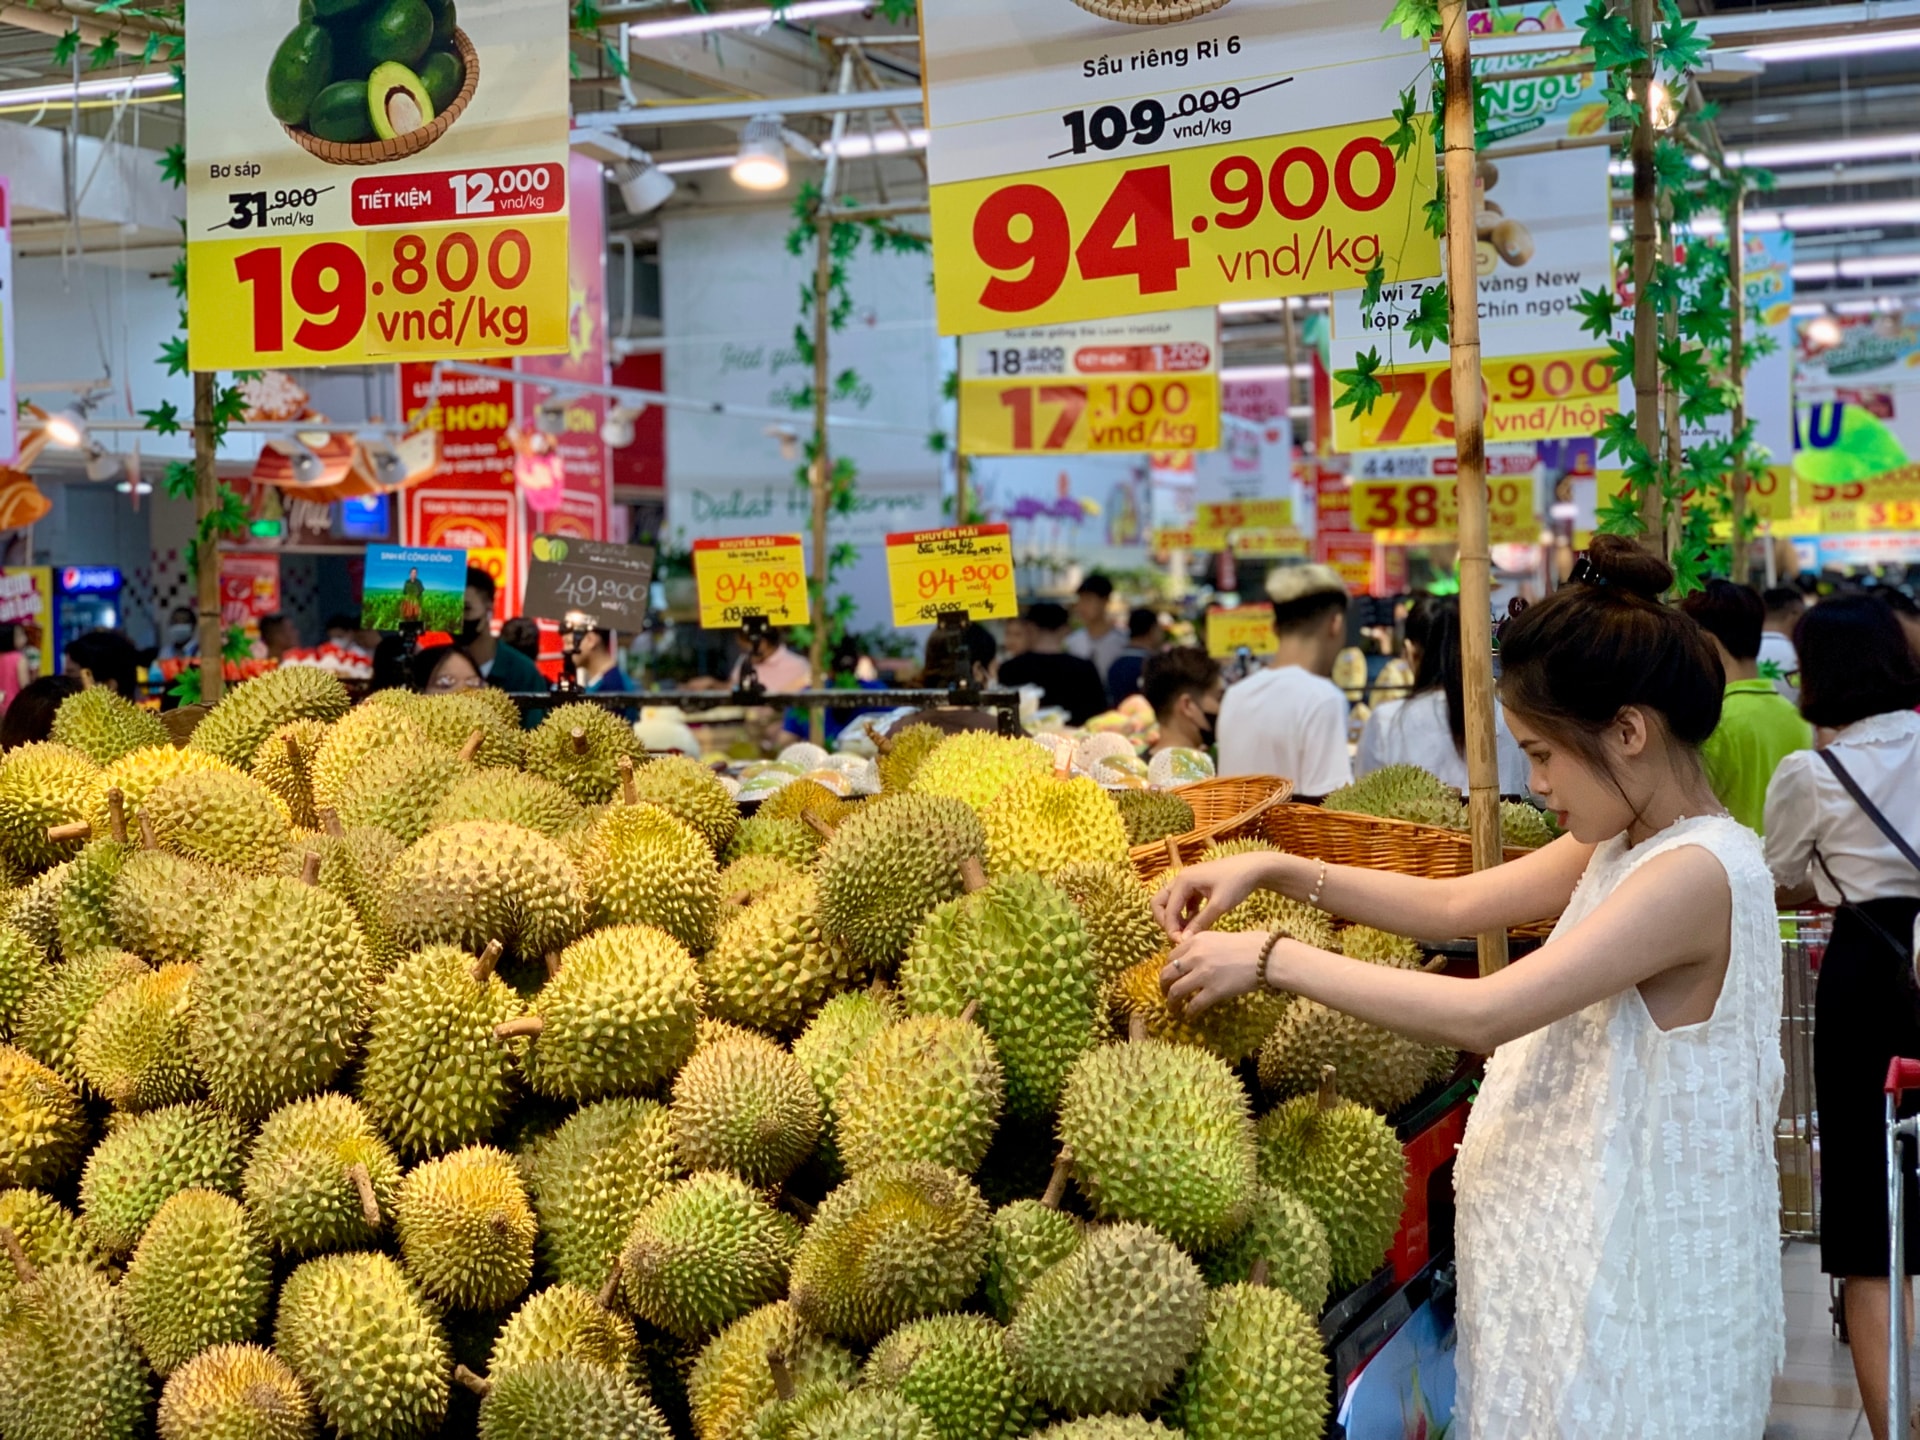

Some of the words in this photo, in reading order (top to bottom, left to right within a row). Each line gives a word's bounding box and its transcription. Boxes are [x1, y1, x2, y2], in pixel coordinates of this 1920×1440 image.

[1083, 54, 1123, 78] Sầu
[1131, 45, 1189, 71] riêng
[1196, 38, 1219, 60] Ri
[1227, 35, 1242, 55] 6
[1484, 75, 1577, 112] Ngọt
[1063, 87, 1241, 154] 109.000
[1173, 117, 1232, 140] vnd/kg
[210, 163, 231, 178] Bơ
[234, 161, 261, 177] sáp
[358, 188, 392, 210] TIẾT
[394, 186, 431, 209] KIỆM
[449, 167, 550, 214] 12.000
[499, 194, 545, 209] vnd/kg
[228, 189, 317, 229] 31.900
[270, 211, 314, 227] vnd/kg
[972, 137, 1396, 312] 94.900
[1218, 226, 1382, 280] vnd/kg
[234, 228, 531, 352] 19.800
[1478, 275, 1528, 293] vàng
[1536, 271, 1581, 287] New
[377, 295, 529, 346] vnđ/kg
[446, 402, 508, 432] HƠN
[914, 529, 957, 543] KHUYẾN
[958, 527, 978, 539] MÃI
[556, 572, 648, 607] 49.900
